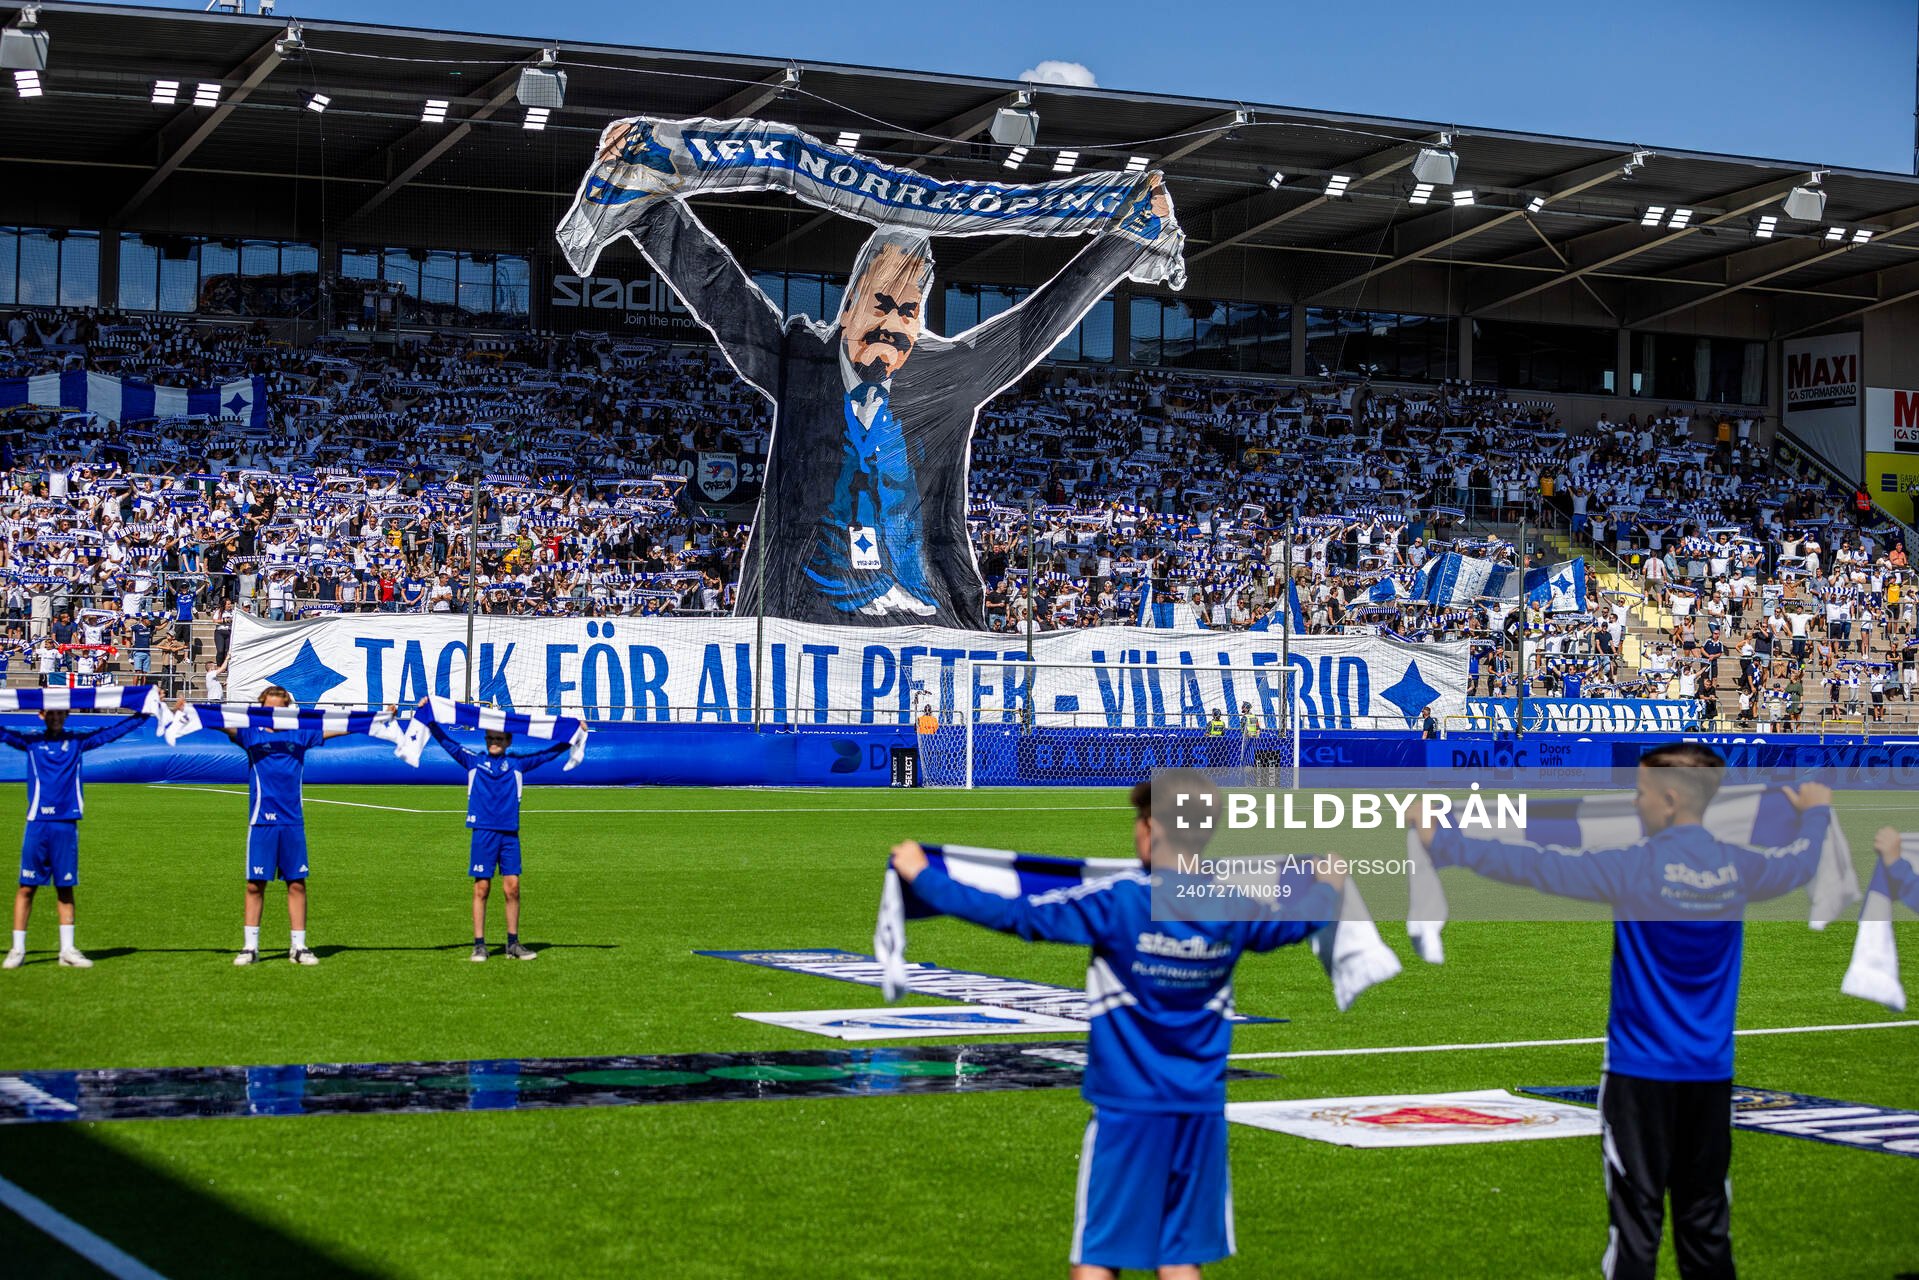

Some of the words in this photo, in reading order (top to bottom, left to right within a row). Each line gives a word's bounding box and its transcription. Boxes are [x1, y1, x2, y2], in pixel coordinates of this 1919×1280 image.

[690, 138, 786, 162] IFK
[799, 149, 1126, 215] NORRKÖPING
[624, 313, 645, 325] Join
[649, 314, 669, 326] the
[1788, 352, 1857, 389] MAXI
[1788, 390, 1799, 401] ICA
[1800, 384, 1857, 400] STORMARKNAD
[1894, 429, 1909, 439] ICA
[1526, 543, 1534, 554] H
[355, 637, 516, 719] TACK
[546, 621, 671, 722] FÖR
[860, 645, 1037, 724] PETER
[1539, 743, 1571, 754] Doors
[1036, 744, 1209, 769] BAUHAUS
[1452, 750, 1528, 772] DALOC
[1539, 755, 1563, 766] with
[905, 756, 913, 786] SELECT
[1539, 767, 1586, 779] purpose.
[265, 813, 277, 821] VK
[253, 866, 264, 875] VK
[473, 864, 484, 872] AS
